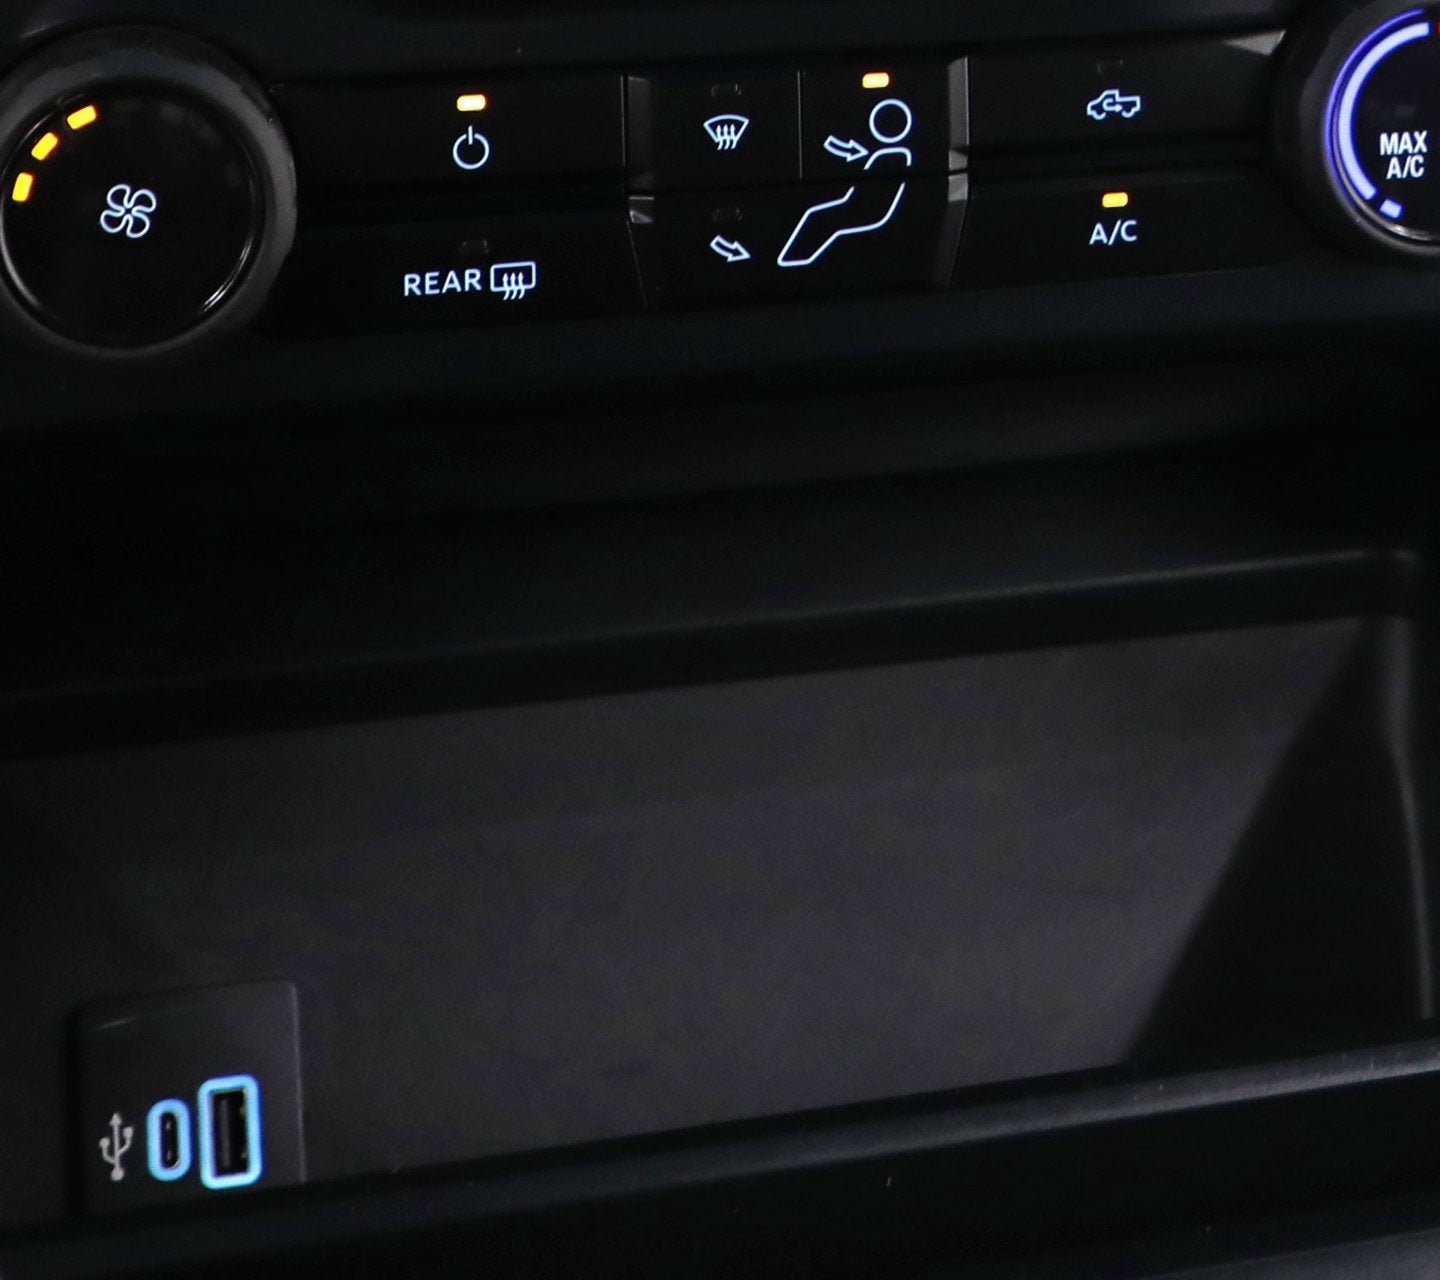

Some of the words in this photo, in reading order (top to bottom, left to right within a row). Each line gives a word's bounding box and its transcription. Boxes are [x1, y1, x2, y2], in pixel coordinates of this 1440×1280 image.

[1379, 130, 1428, 156] MAX
[1386, 153, 1426, 180] A/C
[1089, 219, 1137, 246] A/C
[404, 268, 482, 297] REAR
